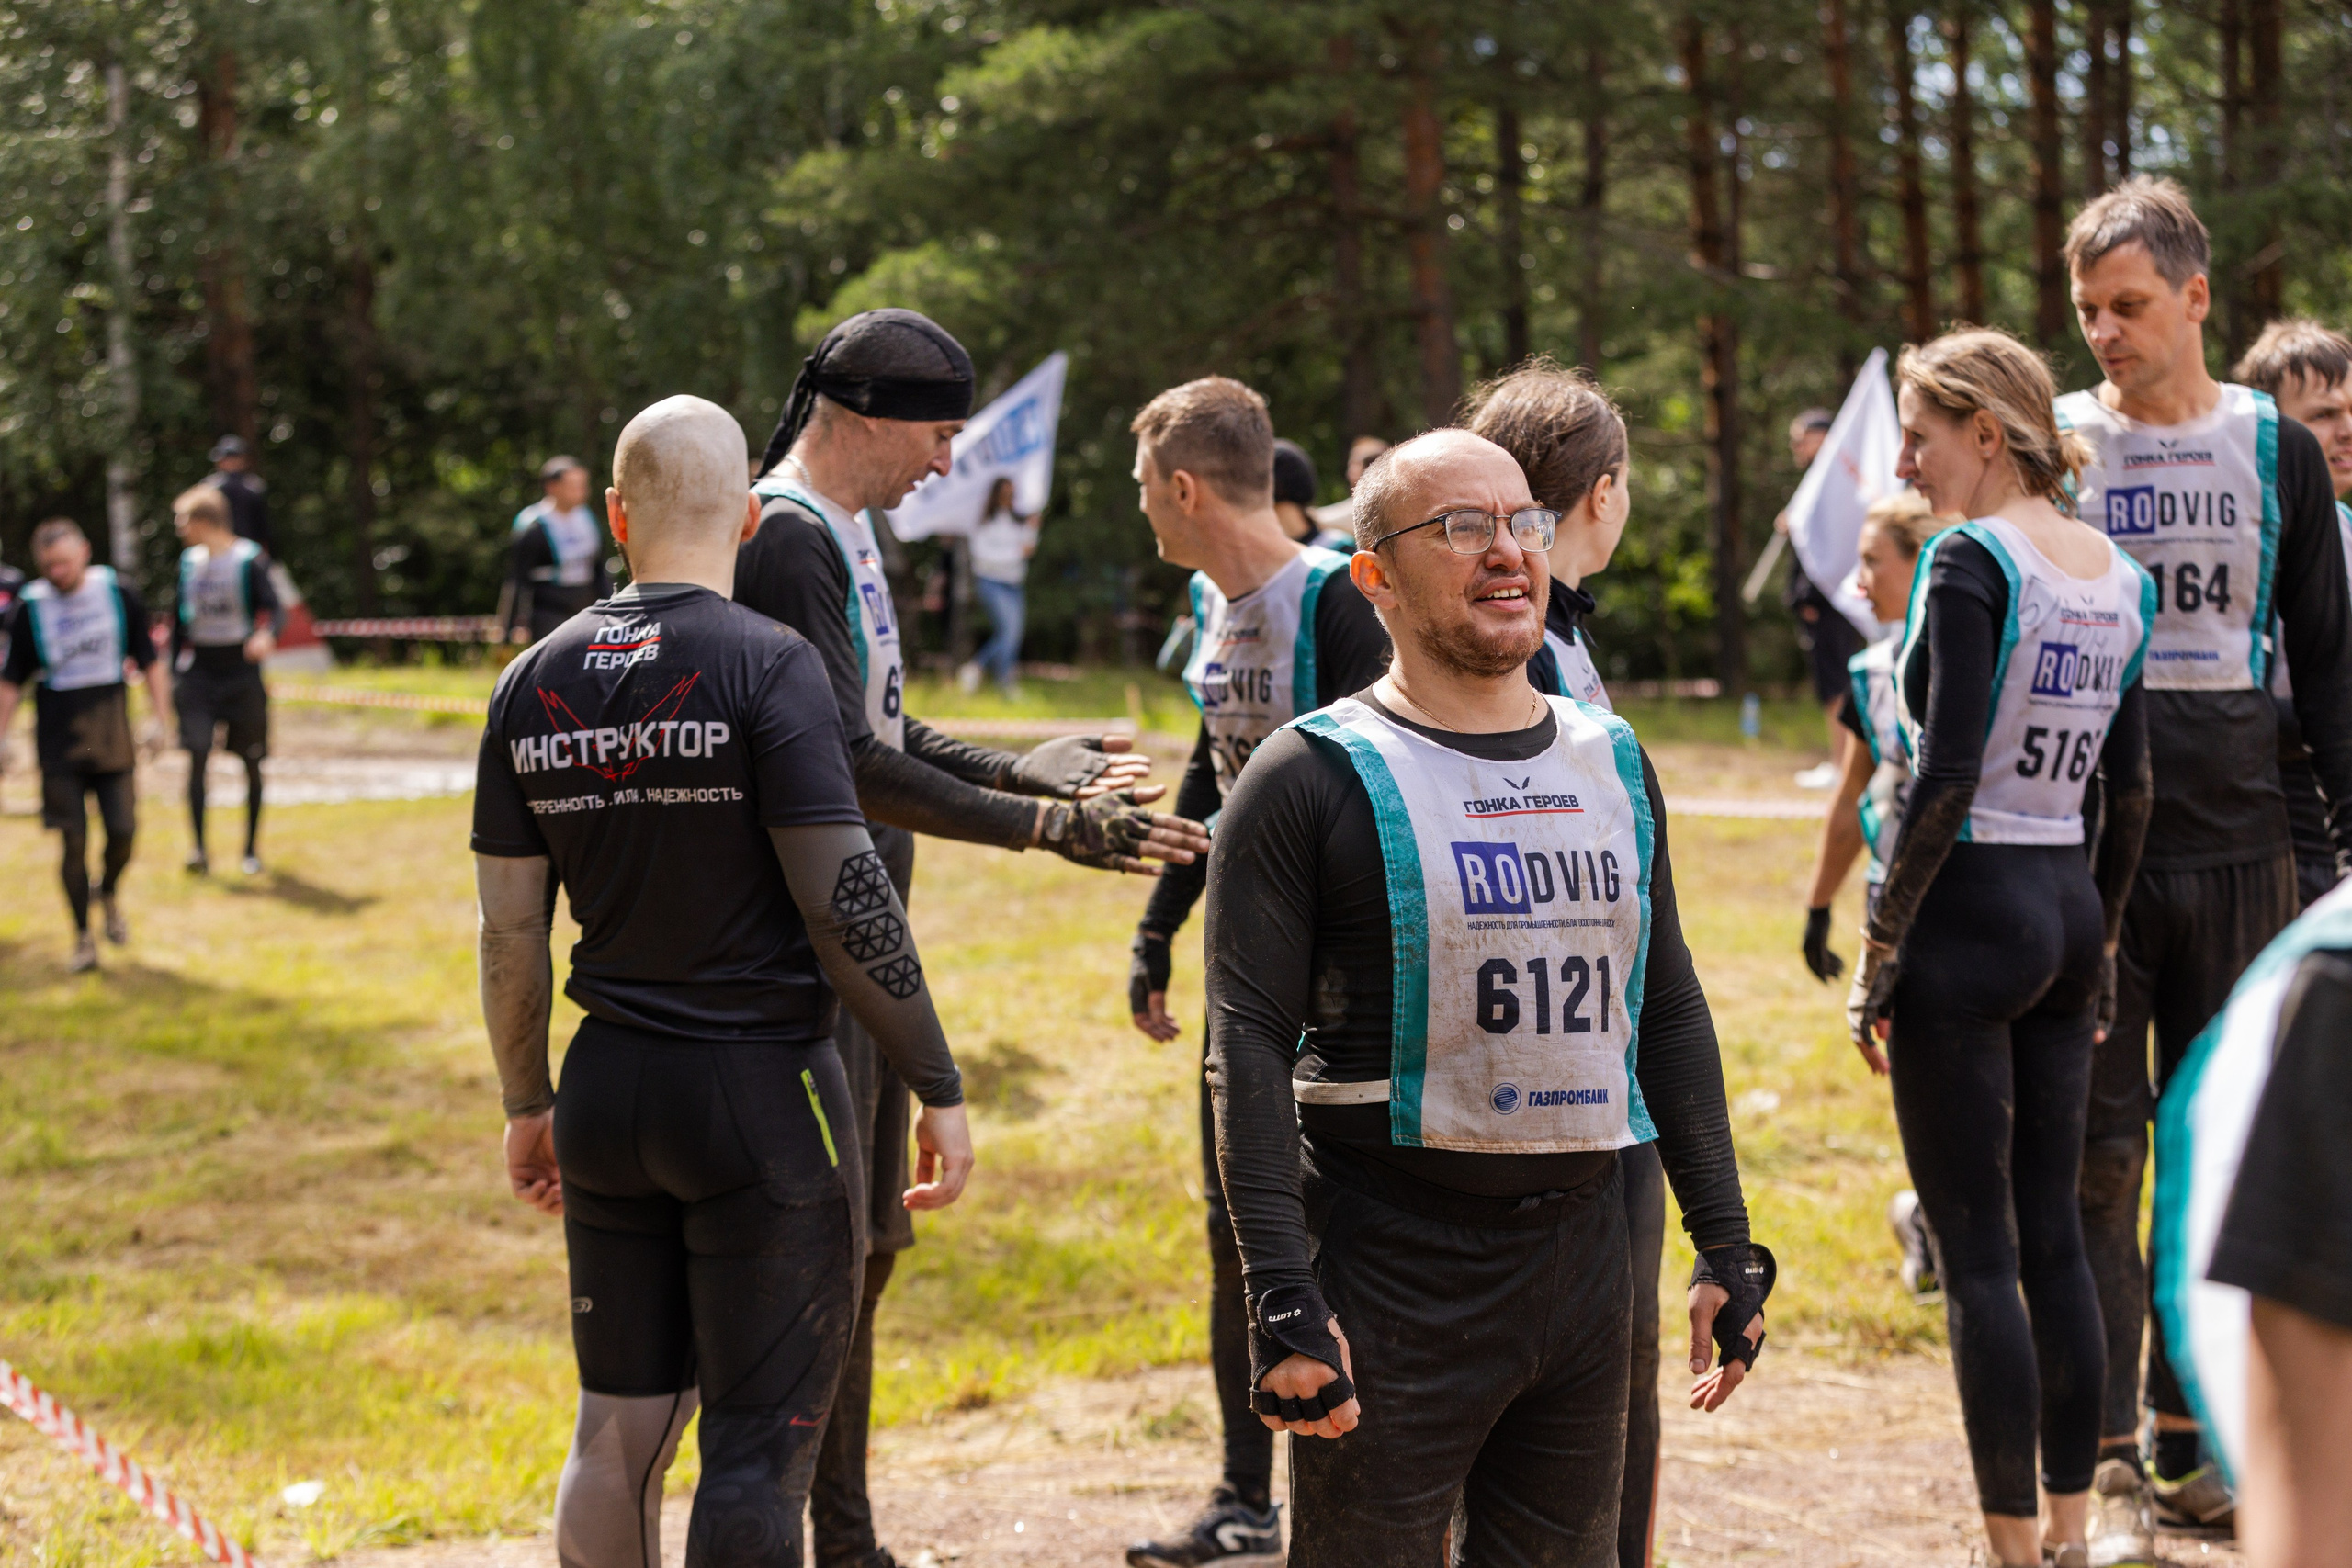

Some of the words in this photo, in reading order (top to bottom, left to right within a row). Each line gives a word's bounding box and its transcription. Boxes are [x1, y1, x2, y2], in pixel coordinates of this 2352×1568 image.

[2109, 490, 2236, 532] RODVIG
[2148, 562, 2231, 614] 164
[594, 622, 662, 644] ГОНКА
[583, 644, 660, 670] ГЕРОЕВ
[510, 720, 730, 774] ИНСТРУКТОР
[646, 787, 744, 806] НАДЕЖНОСТЬ
[1463, 796, 1521, 814] ГОНКА
[1522, 795, 1579, 809] ГЕРОЕВ
[1460, 850, 1621, 904] RODVIG
[1467, 921, 1506, 931] НАДЕЖНОСТЬ
[1476, 955, 1610, 1035] 6121
[1528, 1089, 1609, 1107] ГАЗПРОМБАНК
[1269, 1311, 1292, 1322] LOTTO
